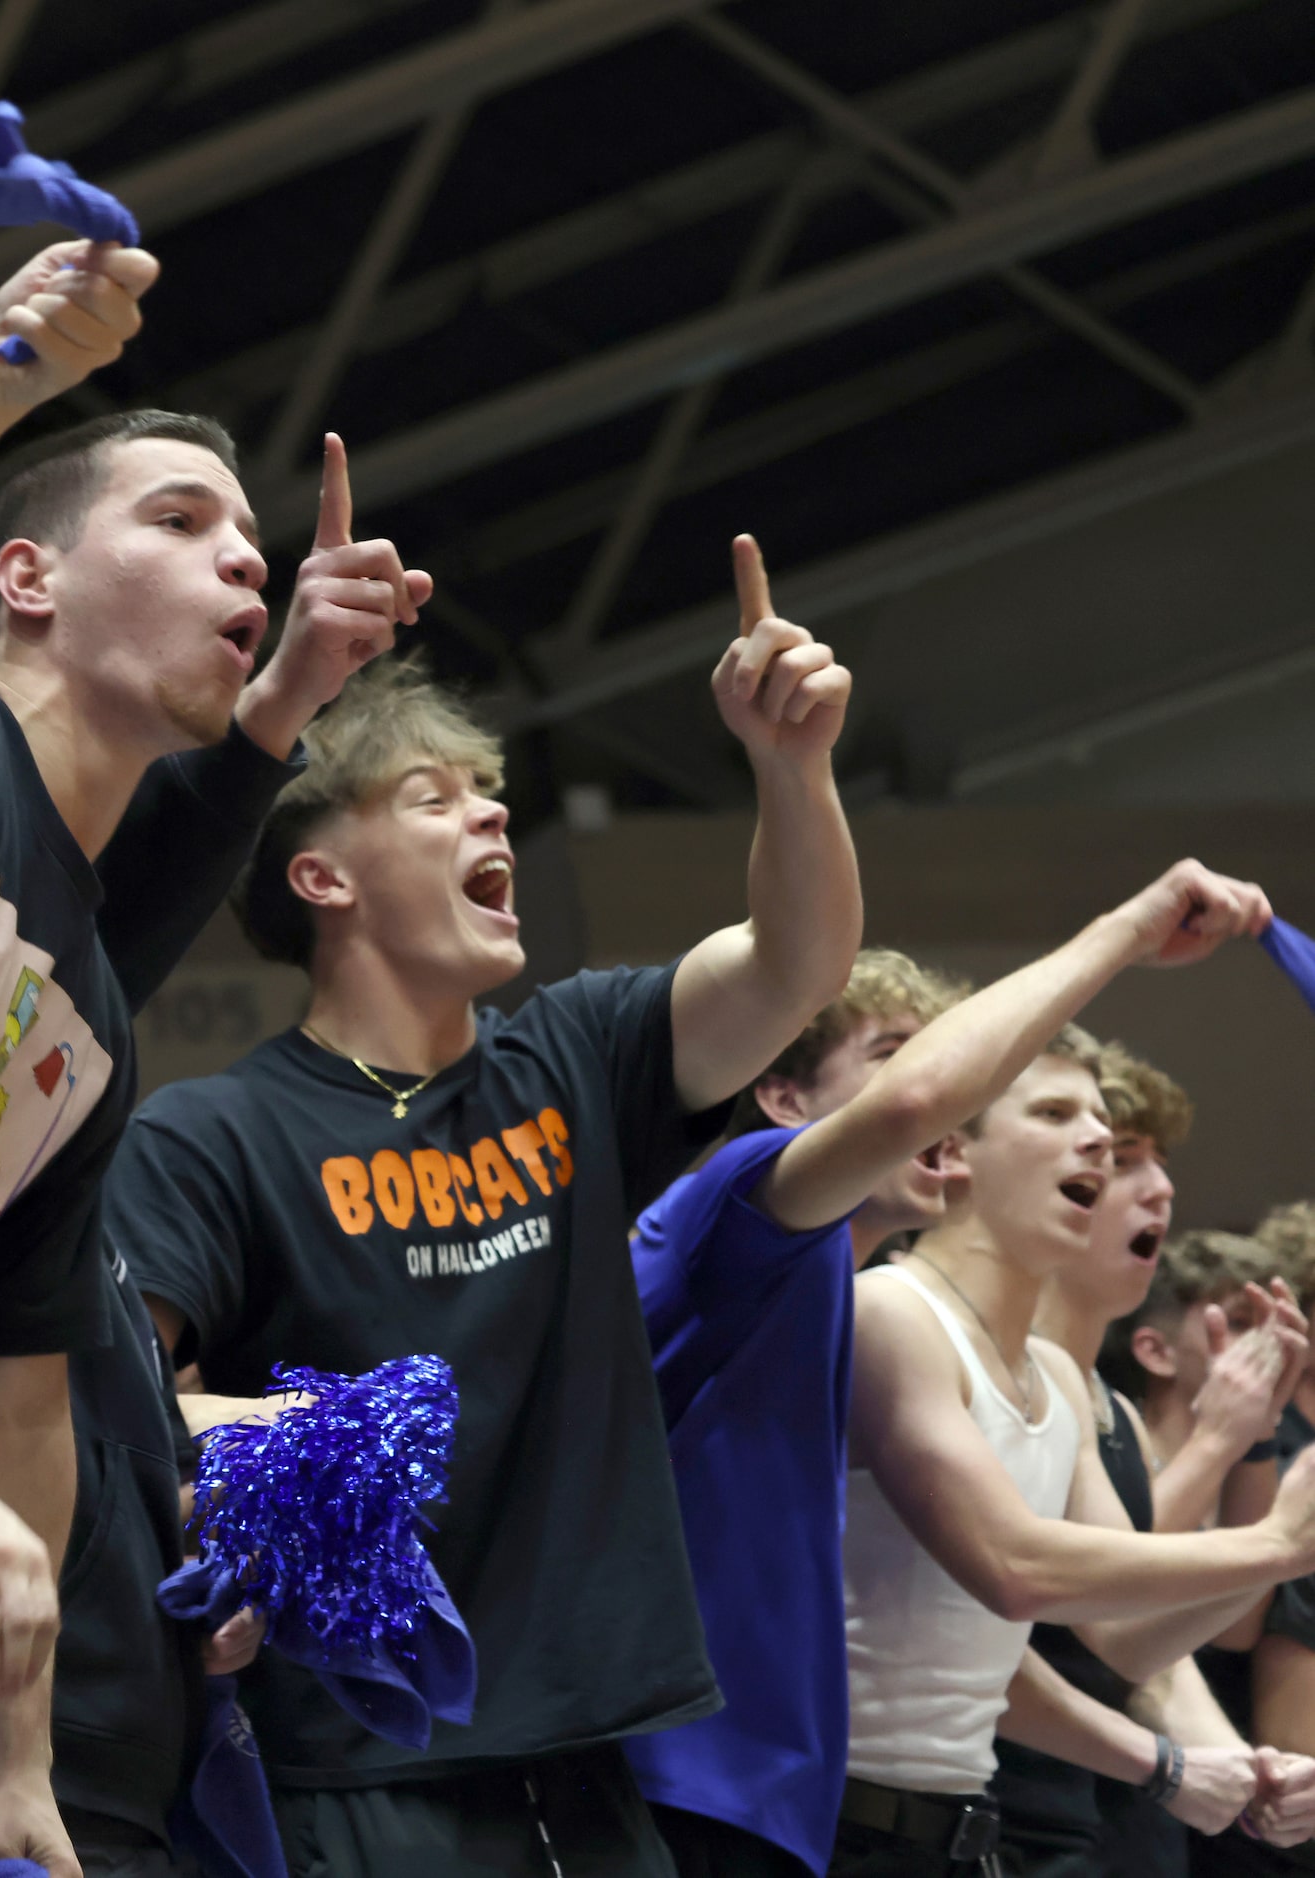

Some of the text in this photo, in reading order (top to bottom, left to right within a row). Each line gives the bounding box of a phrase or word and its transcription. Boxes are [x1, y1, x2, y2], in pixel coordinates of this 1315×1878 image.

[321, 1107, 574, 1235] BOBCATS
[406, 1215, 551, 1278] ON HALLOWEEN
